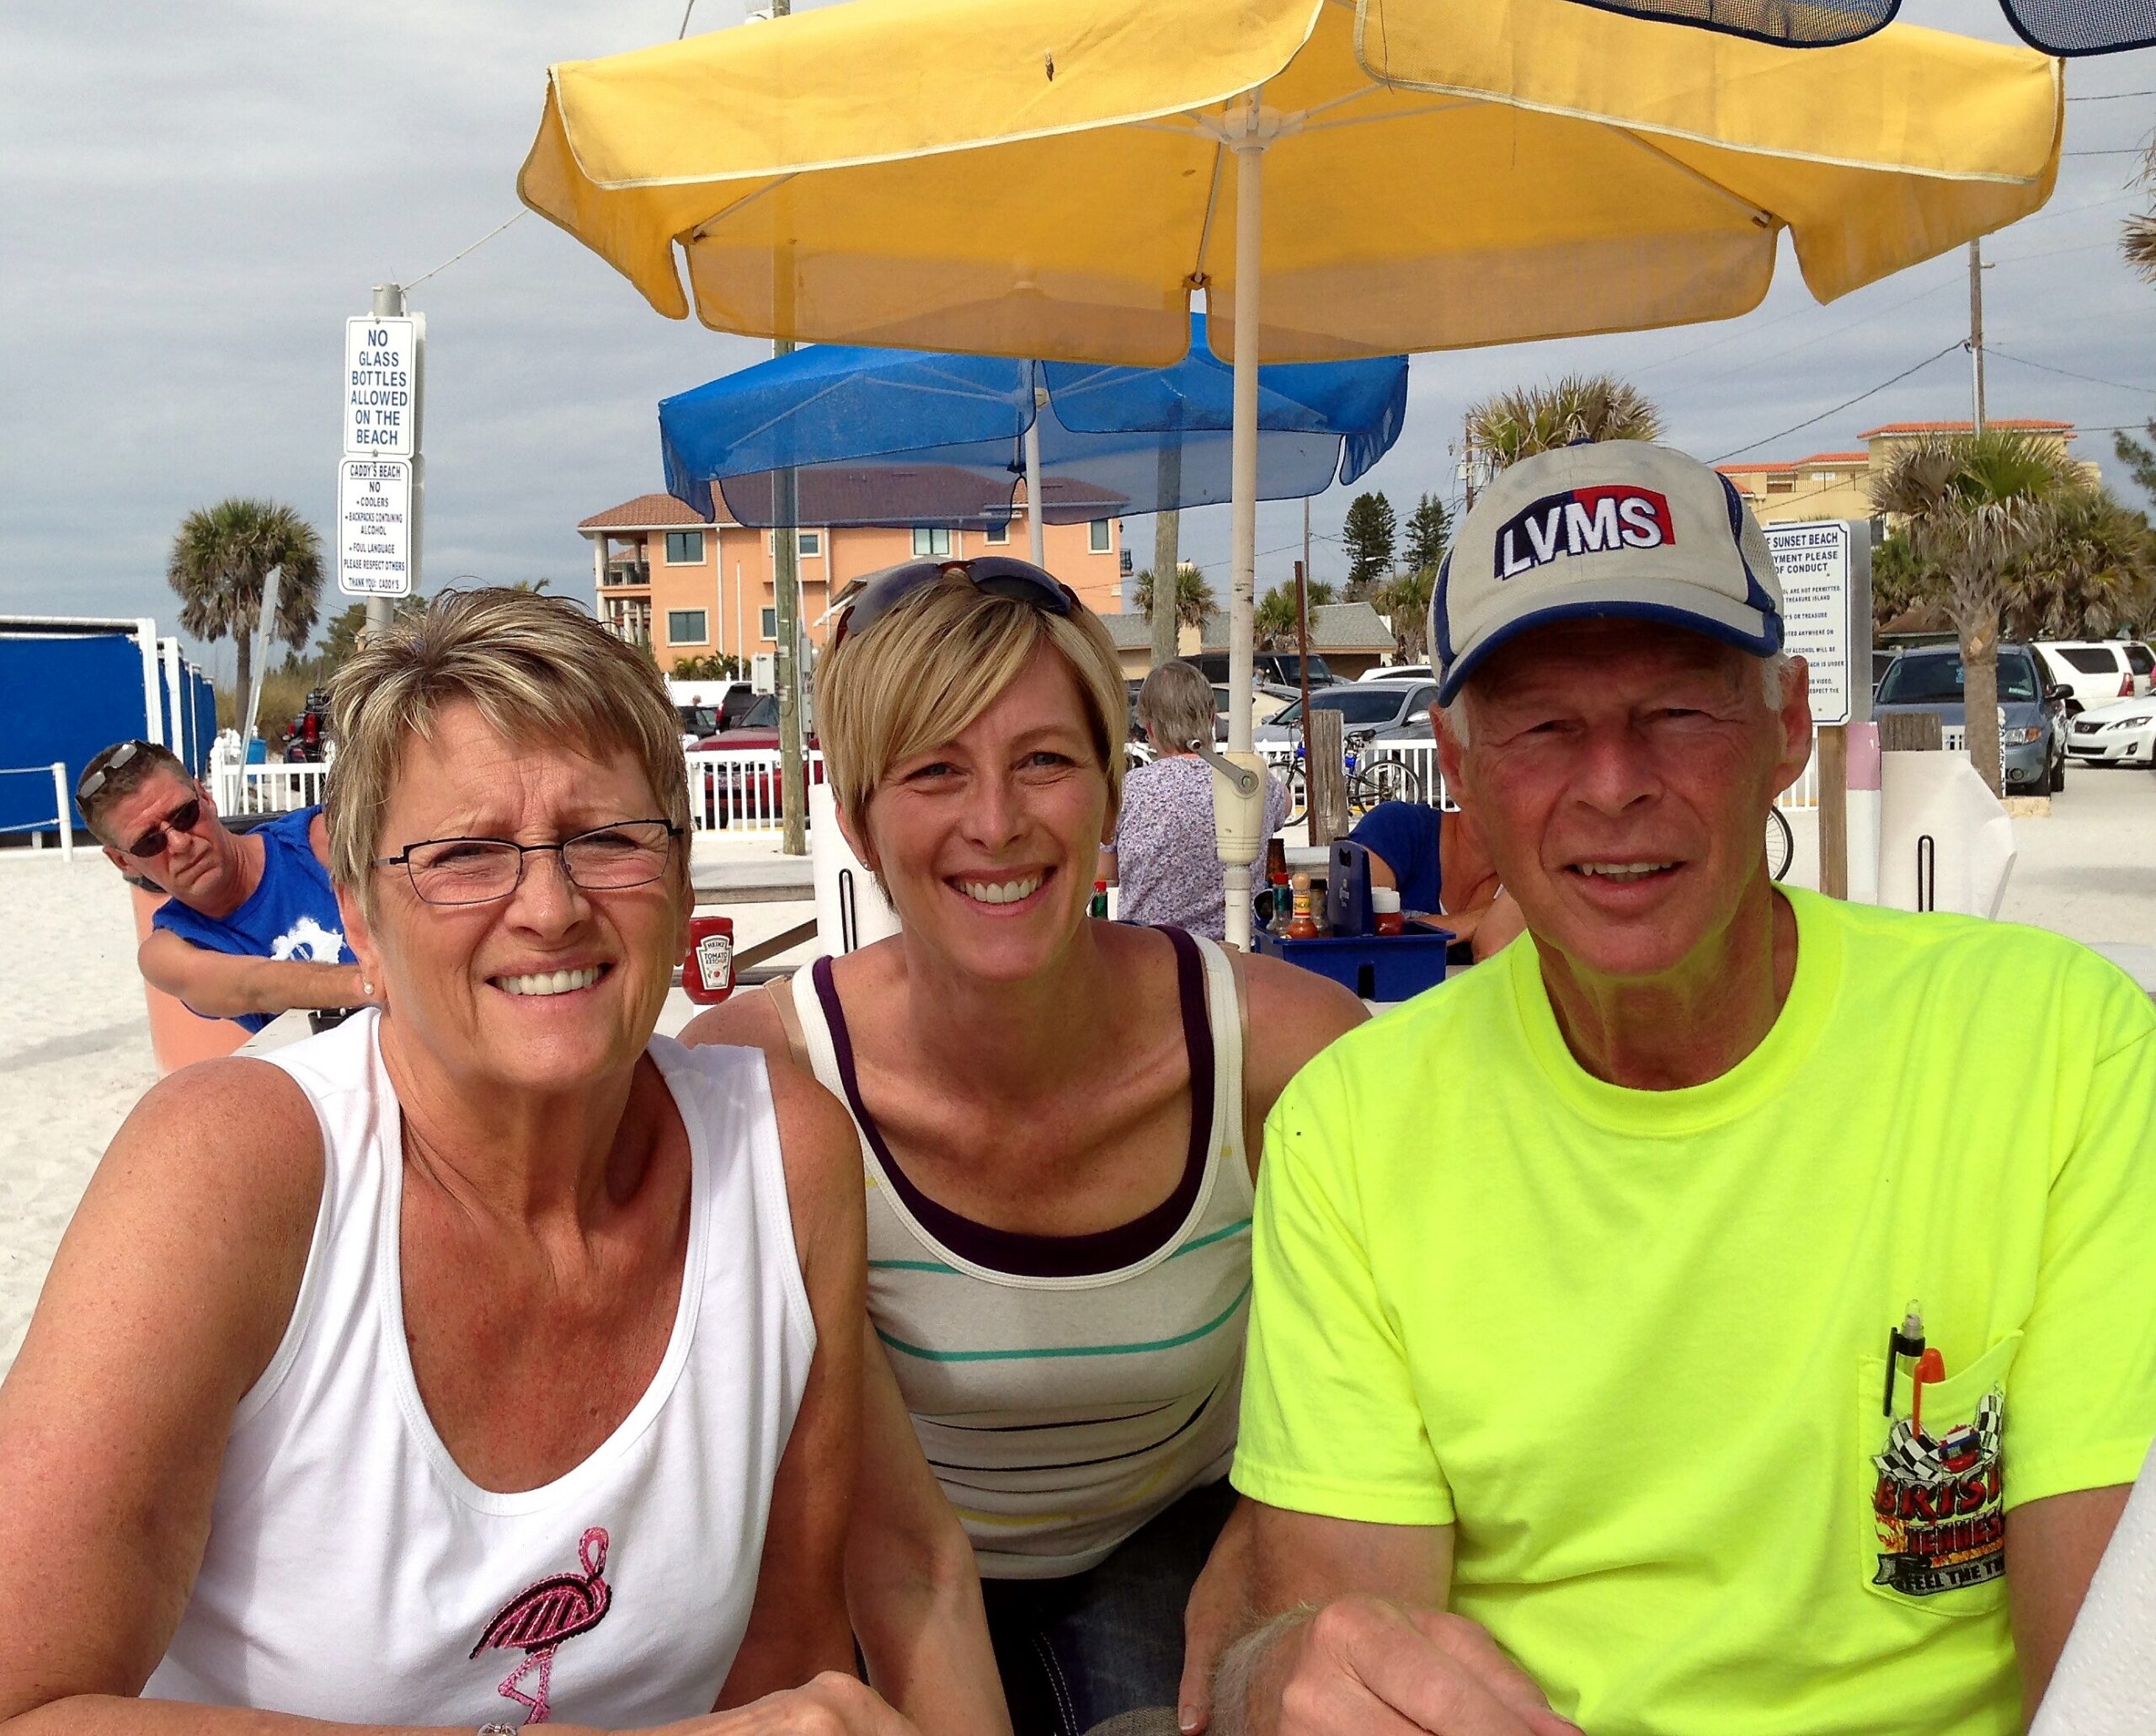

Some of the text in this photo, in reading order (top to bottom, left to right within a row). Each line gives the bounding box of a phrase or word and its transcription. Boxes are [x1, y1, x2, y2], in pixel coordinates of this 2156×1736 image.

[368, 329, 388, 346] NO
[359, 351, 399, 366] GLASS
[352, 371, 407, 387] BOTTLES
[351, 390, 408, 406] ALLOWED
[355, 409, 400, 426] ON THE
[356, 429, 398, 446] BEACH
[350, 464, 401, 478] CADDY'S BEACH
[369, 481, 381, 493] NO
[360, 497, 389, 507] COOLERS
[349, 511, 403, 523] BACKPACKS CONTAINING
[360, 525, 387, 536] ALCOHOL
[1502, 496, 1663, 581] LVMS
[1773, 534, 1806, 548] SUNSET
[1809, 532, 1838, 546] BEACH
[354, 542, 395, 554] FOUL LANGUAGE
[1805, 551, 1838, 562] PLEASE
[344, 558, 405, 571] PLEASE RESPECT OTHERS
[1787, 563, 1828, 574] CONDUCT
[349, 577, 365, 587] THANK
[378, 579, 399, 590] CADDY'S
[1798, 628, 1825, 637] ANYWHERE
[1946, 1565, 1982, 1585] THE
